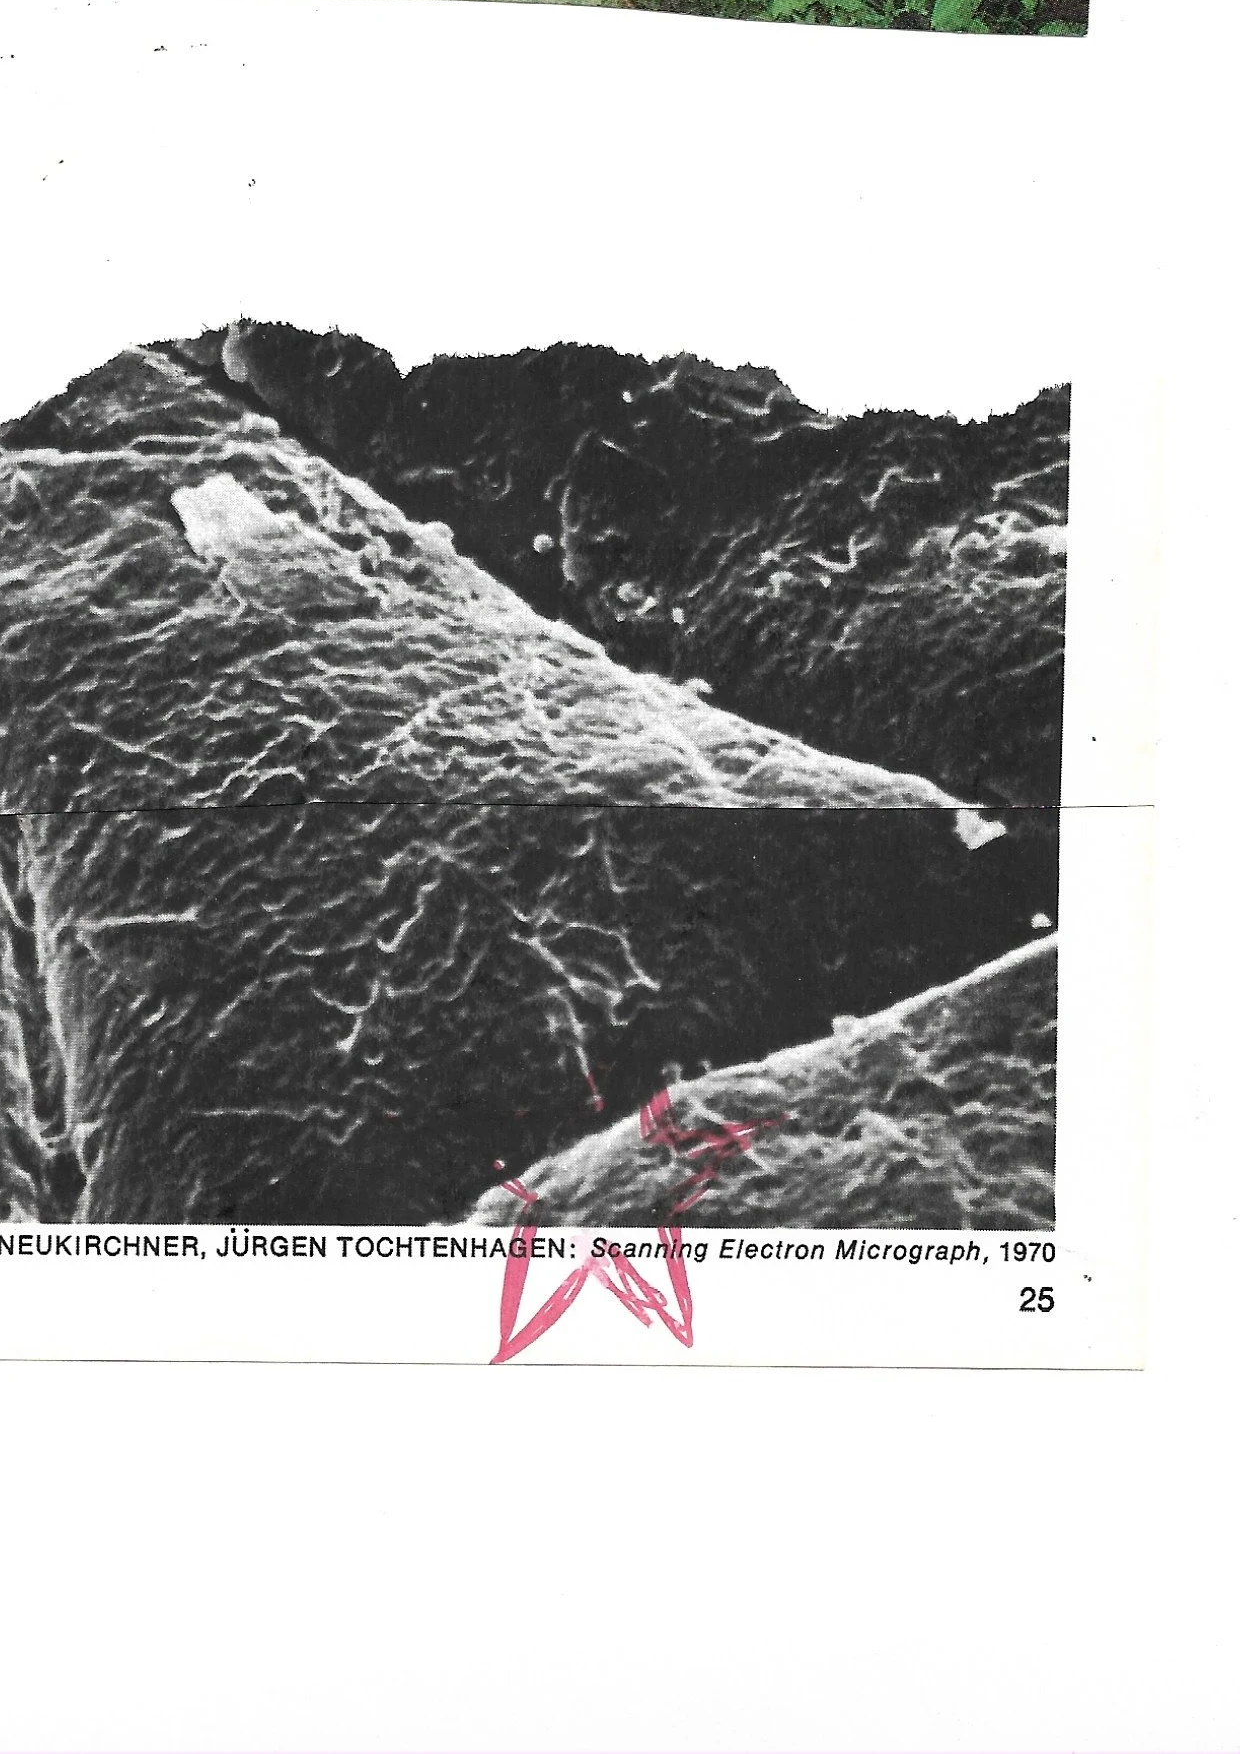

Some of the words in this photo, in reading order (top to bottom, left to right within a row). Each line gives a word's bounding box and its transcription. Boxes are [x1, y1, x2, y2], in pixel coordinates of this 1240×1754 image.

[216, 1228, 327, 1258] JÜRGEN
[336, 1236, 577, 1260] TOCHTENHAGEN:
[591, 1238, 709, 1263] Scanning
[718, 1238, 825, 1260] Electron
[835, 1238, 991, 1265] Micrograph,
[999, 1241, 1056, 1263] 1970
[1018, 1287, 1055, 1313] 25
